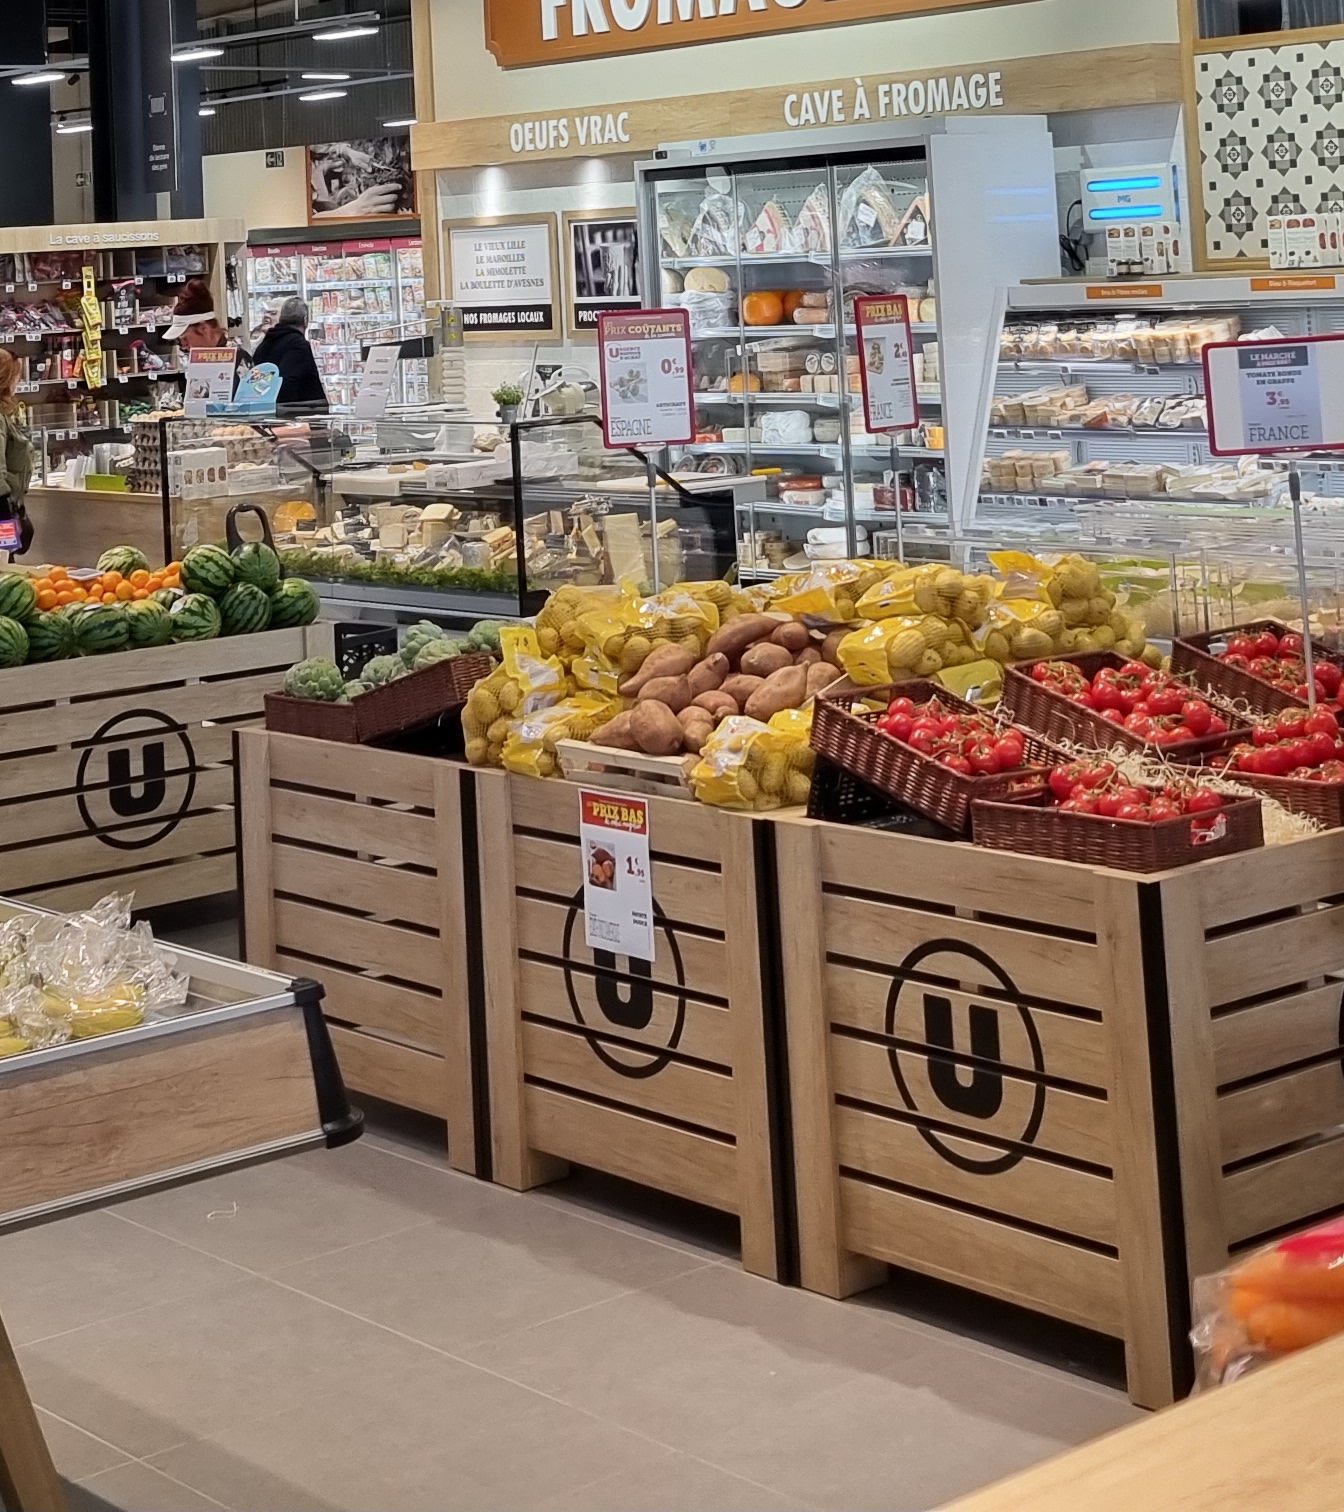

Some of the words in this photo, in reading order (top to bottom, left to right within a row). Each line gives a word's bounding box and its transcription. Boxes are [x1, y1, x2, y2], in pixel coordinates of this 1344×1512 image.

[783, 88, 845, 128] CAVE
[853, 78, 871, 121] À
[878, 72, 1004, 118] FROMAGE
[509, 118, 569, 154] OEUFS
[574, 112, 630, 146] VRAC
[49, 233, 63, 246] La
[65, 234, 91, 245] cave
[102, 231, 160, 243] saucissons
[473, 242, 483, 252] LE
[483, 241, 505, 251] VIEUX
[506, 240, 526, 250] LILLE
[475, 255, 485, 265] LE
[485, 253, 526, 264] MAROILLES
[475, 267, 485, 277] LA
[485, 265, 527, 276] MIMOLETTE
[459, 281, 469, 291] LA
[470, 279, 505, 290] BOULETTE
[506, 278, 545, 289] D'AVESNES
[463, 312, 478, 325] NOS
[479, 311, 516, 325] FROMAGES
[517, 310, 545, 323] LOCAUX
[864, 303, 886, 318] PRIX
[885, 303, 903, 317] BAS
[604, 325, 627, 336] PRIX
[627, 323, 683, 334] COÛTANTS
[1249, 353, 1261, 361] LE
[1260, 350, 1296, 360] MARCHÉ
[1246, 370, 1277, 379] TOMATE
[610, 418, 653, 437] ESPAGNE
[1248, 423, 1311, 443] FRANCE
[107, 740, 167, 818] U
[591, 800, 620, 821] PRIX
[620, 805, 645, 825] BAS
[922, 992, 1004, 1120] U
